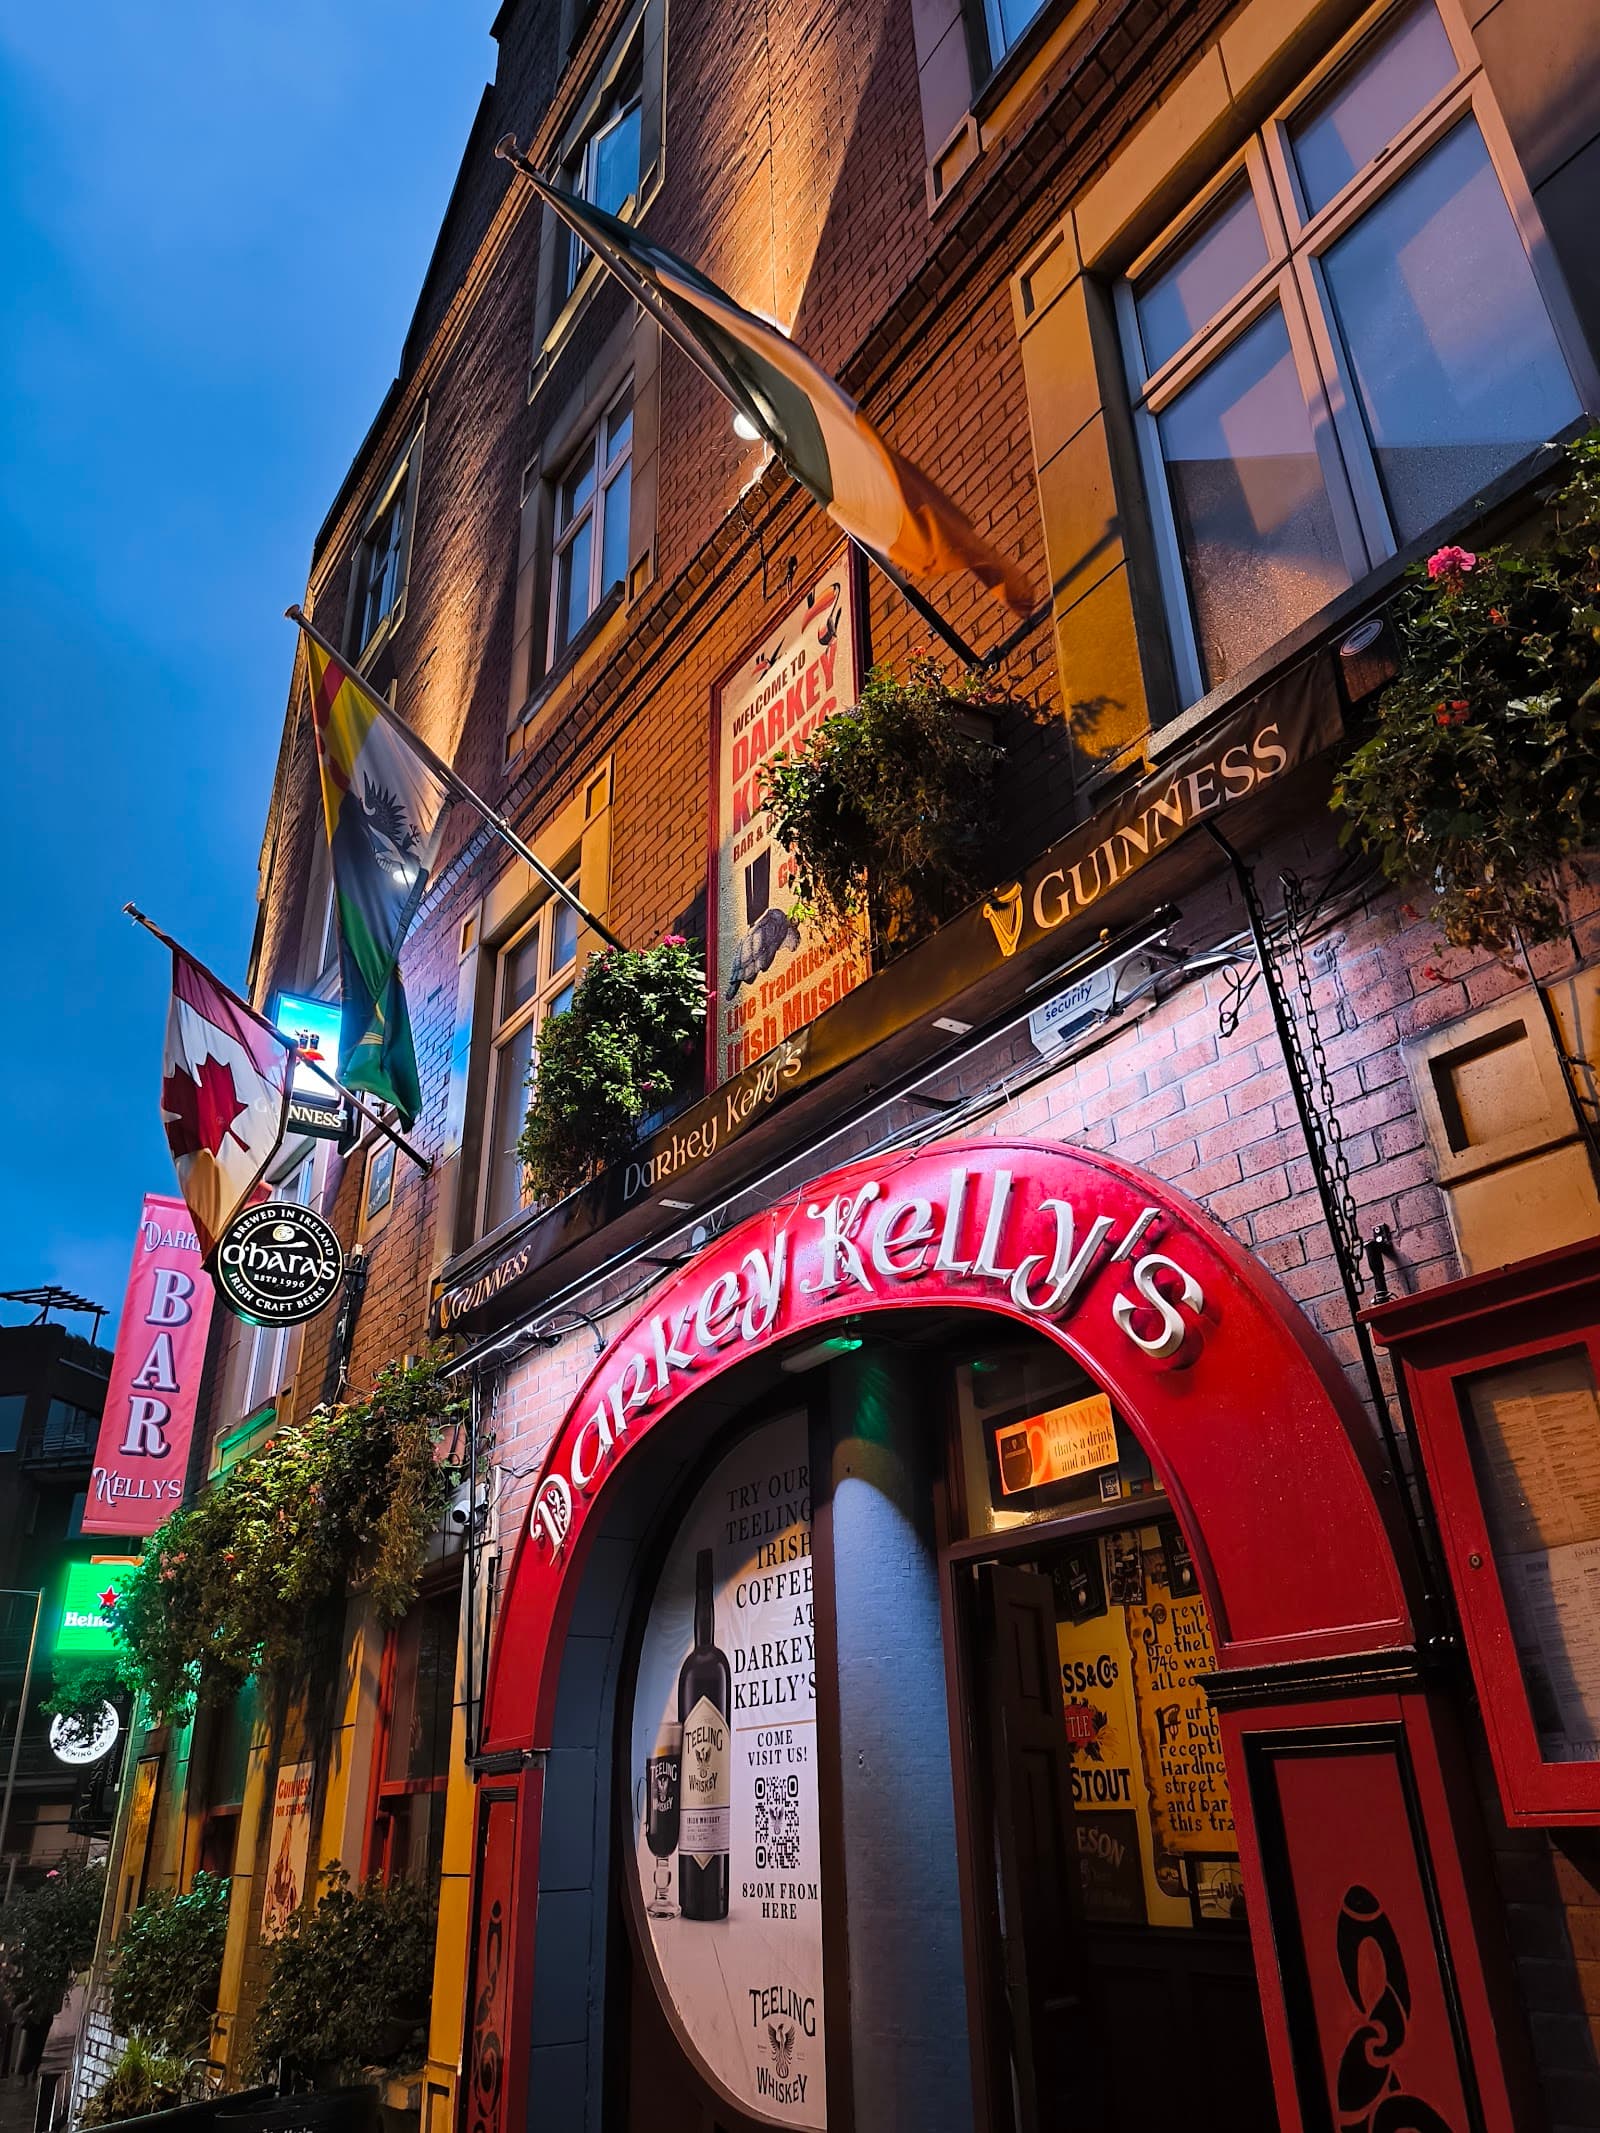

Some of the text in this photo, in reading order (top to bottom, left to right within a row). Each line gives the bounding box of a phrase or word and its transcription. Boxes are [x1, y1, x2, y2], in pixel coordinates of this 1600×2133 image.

[732, 640, 837, 785] DARKEY
[733, 649, 806, 738] WELCOME TO
[733, 826, 763, 864] BAR &
[1033, 723, 1287, 929] GUINNESS
[726, 994, 756, 1035] Live
[727, 960, 857, 1078] Irish Music
[1045, 984, 1092, 1021] security
[623, 1045, 802, 1201] Darkey Kelly's
[232, 1208, 334, 1256] BREWED IN IRELAND
[254, 1274, 306, 1289] ESTD 1996
[452, 1245, 531, 1319] GUINNESS
[800, 1167, 1204, 1359] Kelly's
[228, 1271, 326, 1311] IRISH CRAFT BEERS
[119, 1266, 195, 1458] BAR
[1079, 1438, 1086, 1449] a
[1087, 1426, 1114, 1446] drink
[1062, 1444, 1111, 1472] and a half!
[92, 1467, 183, 1507] KELLYS
[727, 1466, 810, 1512] TRY OUR
[726, 1496, 814, 1545] TEELING
[756, 1531, 812, 1570] IRISH
[736, 1566, 814, 1609] COFFEE
[793, 1603, 815, 1626] AT
[734, 1634, 816, 1674] DARKEY
[1146, 1634, 1209, 1656] brothel
[1148, 1655, 1216, 1674] 1746 was
[734, 1671, 817, 1710] KELLY'S
[685, 1726, 723, 1754] TEELING
[748, 1746, 808, 1767] VISIT US!
[757, 1729, 793, 1748] COME
[278, 1777, 312, 1800] GUINNESS
[650, 1761, 678, 1784] TEELING
[689, 1772, 718, 1793] WHISKEY
[1071, 1769, 1131, 1803] STOUT
[1165, 1776, 1216, 1794] street
[275, 1804, 285, 1817] FOR
[1168, 1793, 1228, 1813] and bar
[1169, 1812, 1203, 1832] this
[742, 1882, 818, 1900] 820M FROM
[762, 1902, 798, 1920] HERE
[749, 1985, 816, 2037] TEELING
[756, 2066, 808, 2104] WHISKEY
